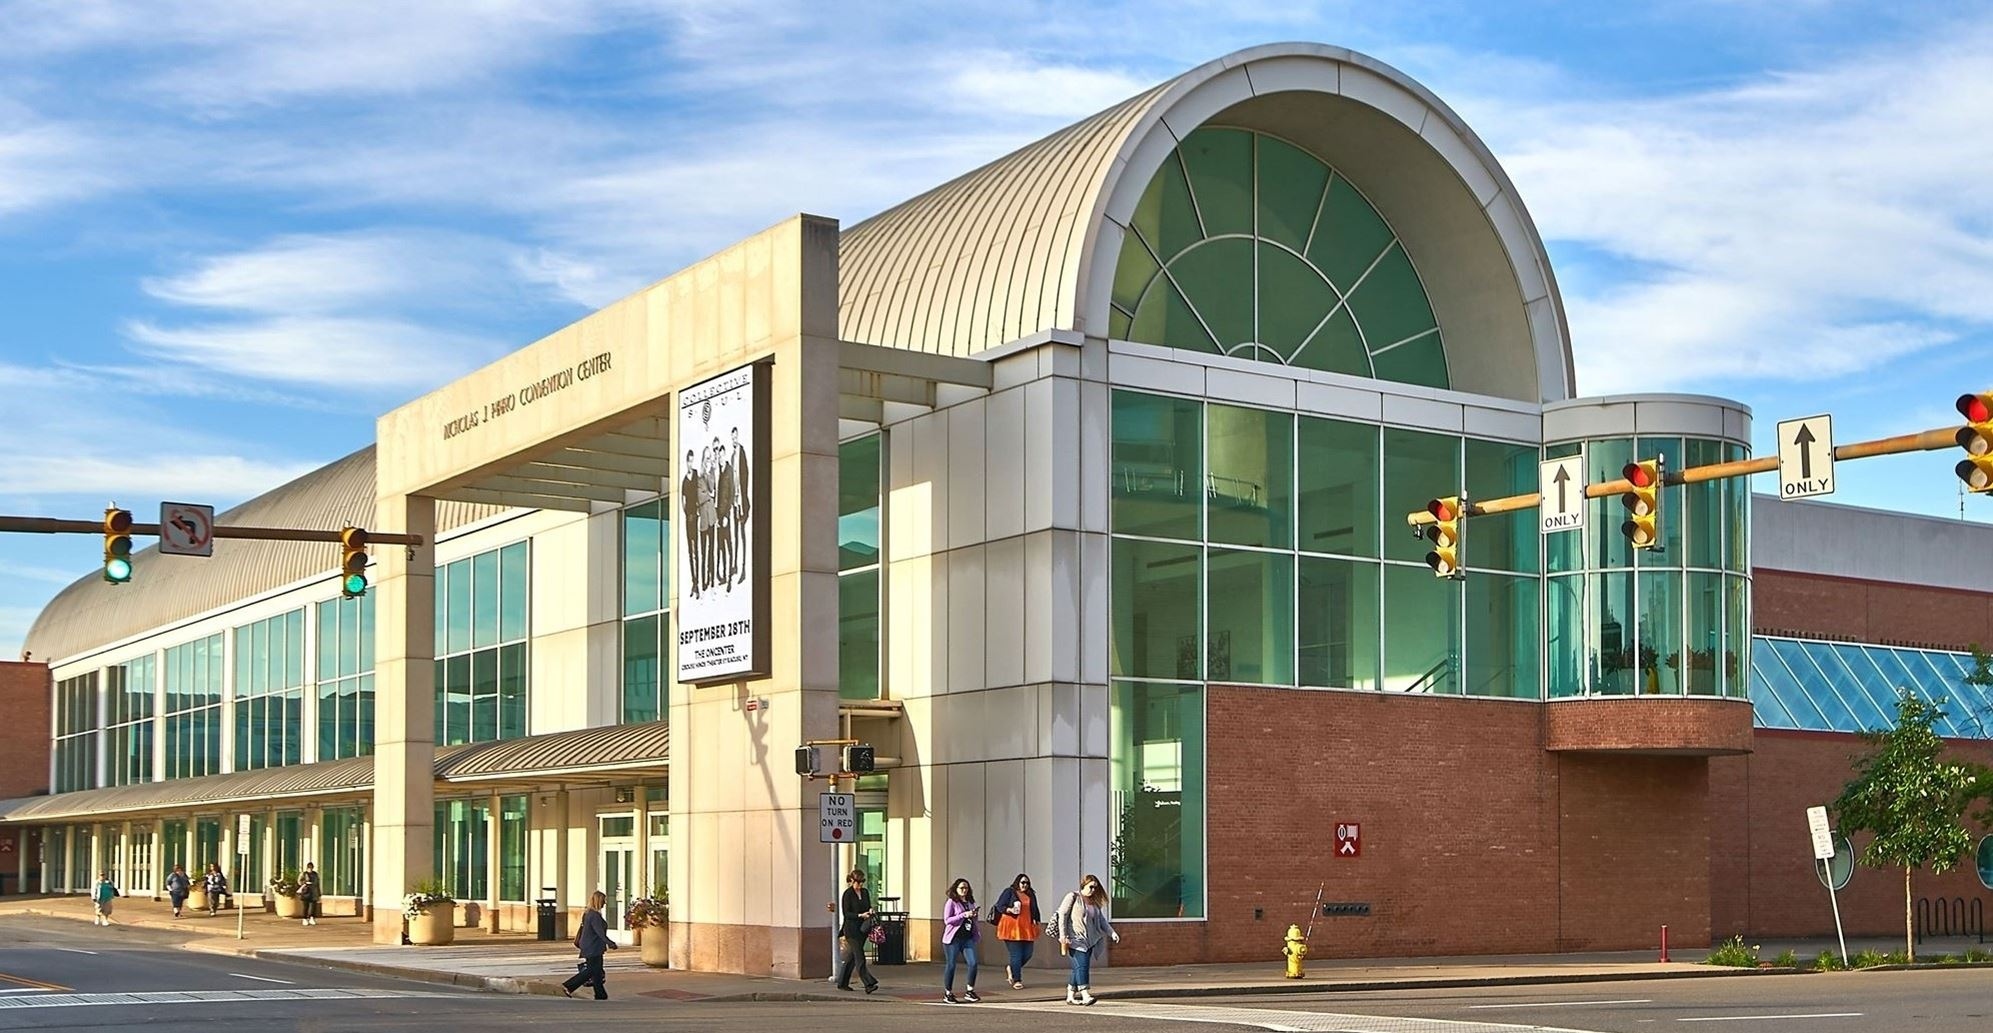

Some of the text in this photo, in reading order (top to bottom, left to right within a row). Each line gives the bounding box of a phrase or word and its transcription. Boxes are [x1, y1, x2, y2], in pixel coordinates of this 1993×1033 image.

[519, 367, 573, 406] CONVENTION
[577, 352, 611, 381] CENTER
[1785, 478, 1829, 495] ONLY
[1545, 513, 1579, 528] ONLY
[680, 619, 750, 645] SEPTEMBER 28TH
[828, 796, 846, 806] NO
[827, 808, 848, 816] TURN
[821, 819, 853, 828] ON RED
